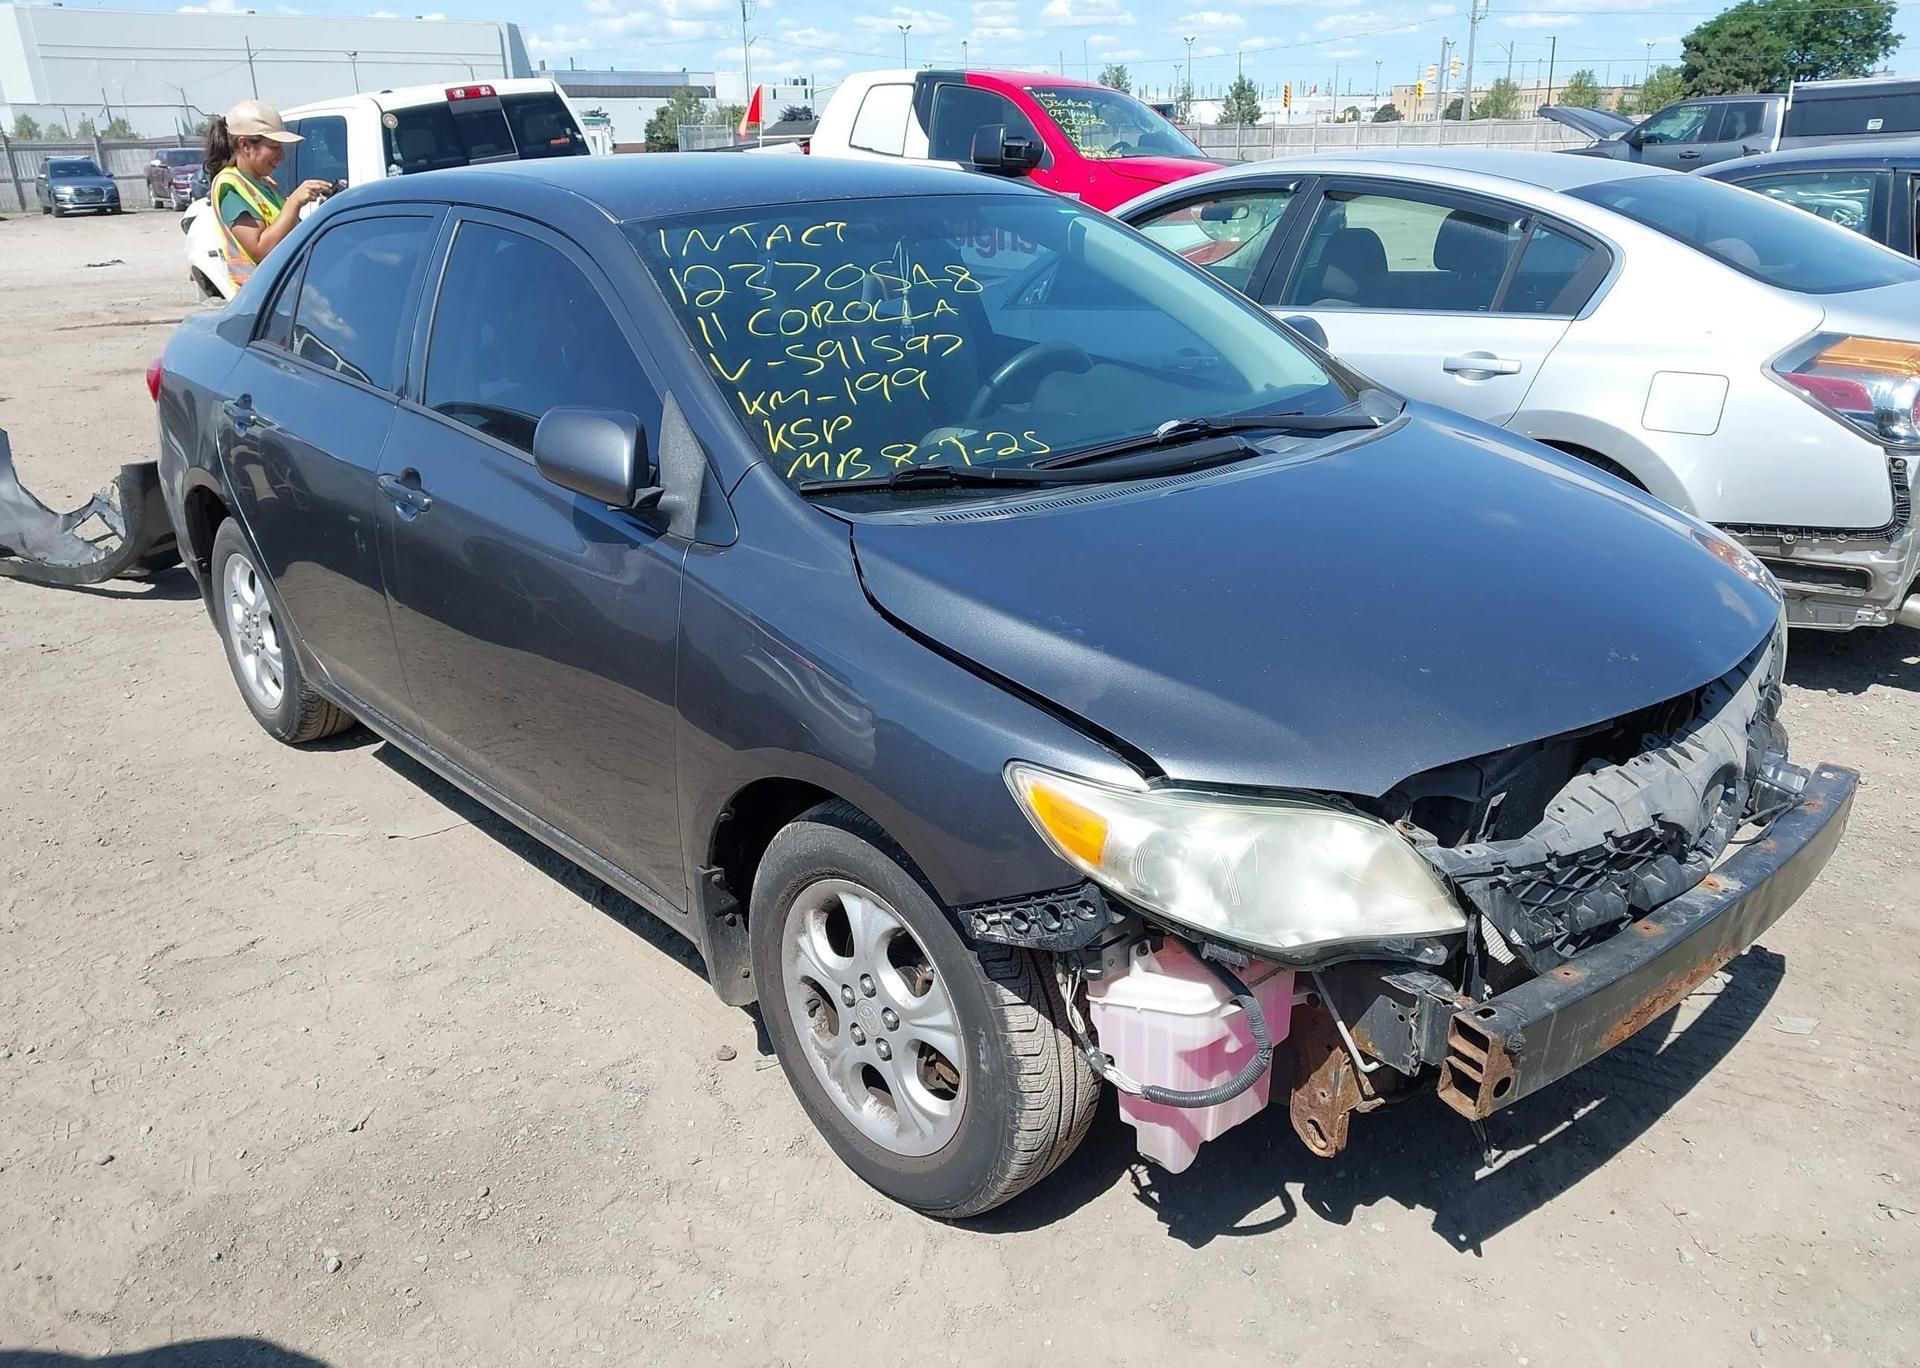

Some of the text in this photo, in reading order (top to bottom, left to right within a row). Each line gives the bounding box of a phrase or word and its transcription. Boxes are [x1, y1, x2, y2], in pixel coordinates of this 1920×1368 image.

[660, 221, 847, 257] INTACT
[748, 300, 960, 338] COROLLA
[763, 415, 853, 454] KSP
[788, 446, 871, 480] MB
